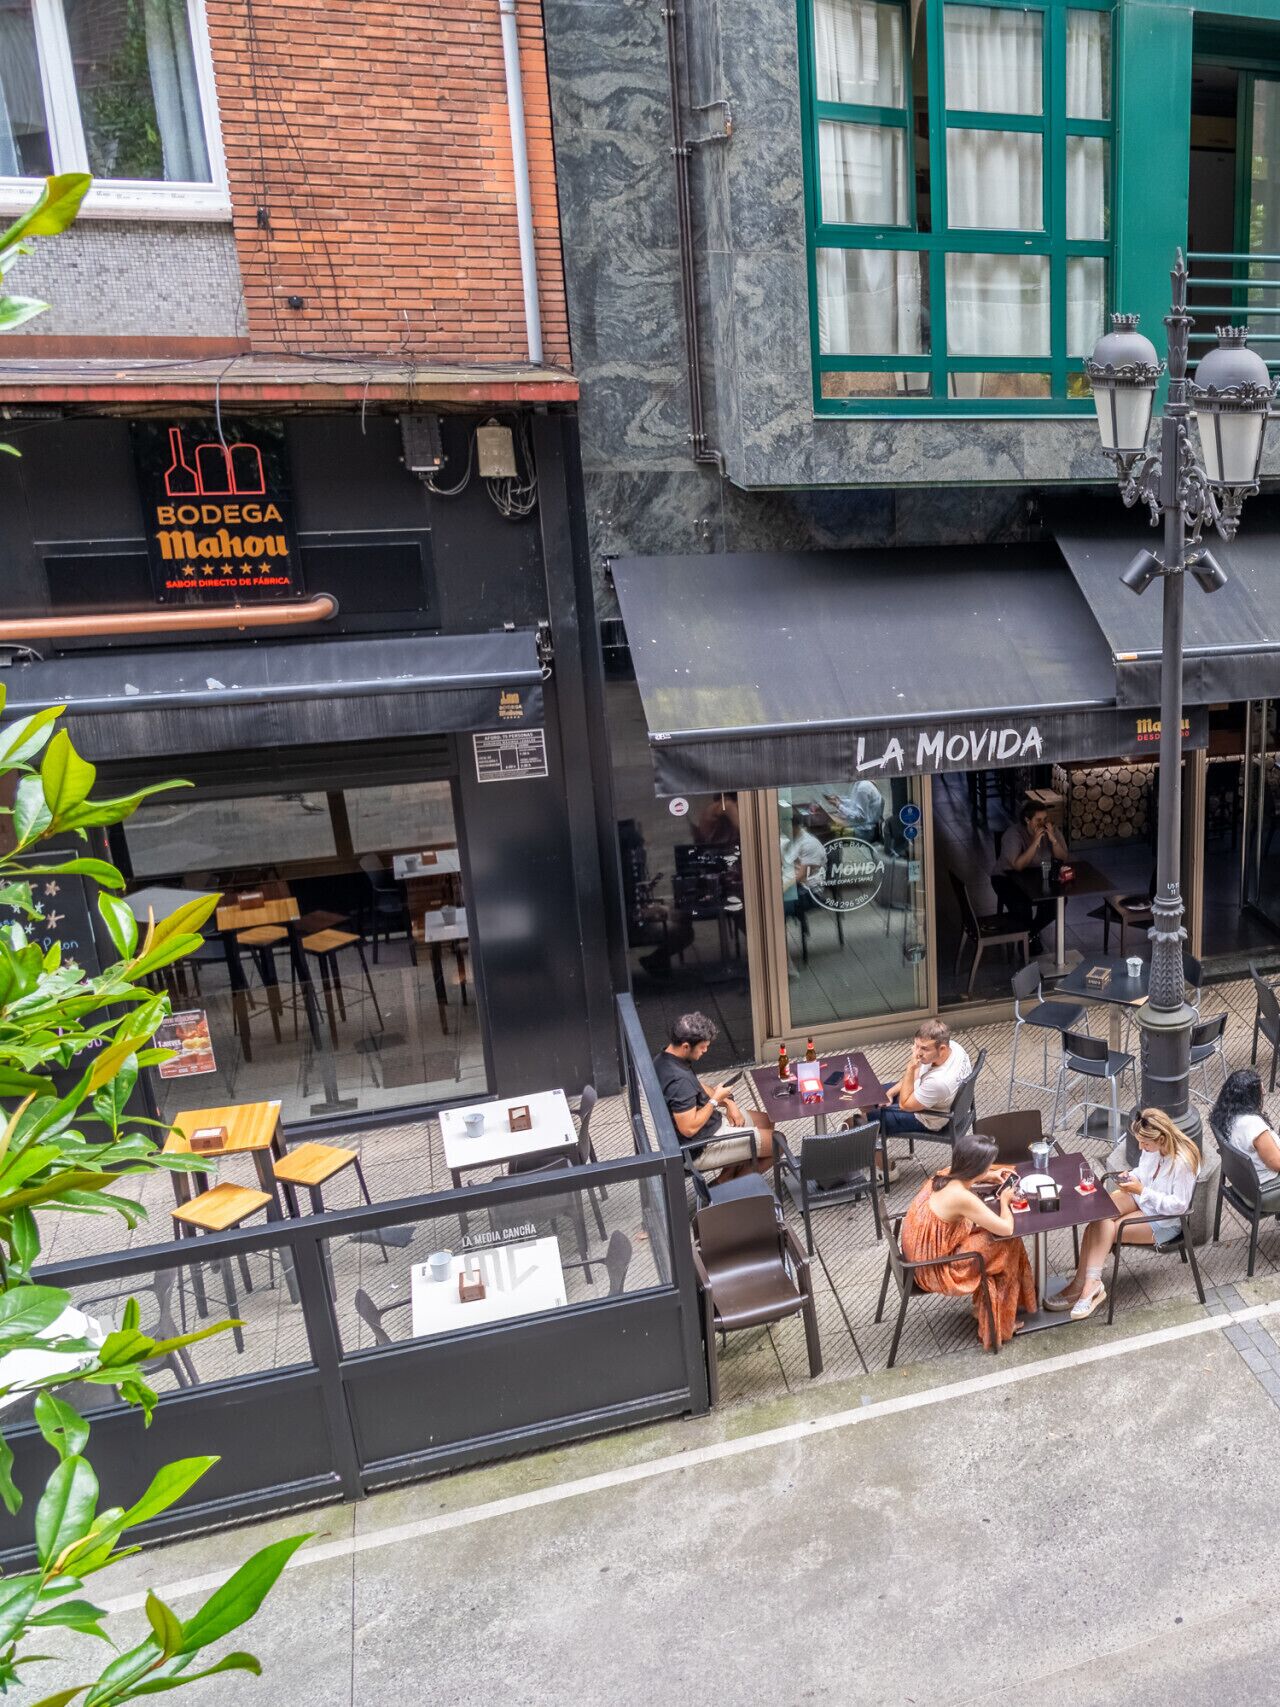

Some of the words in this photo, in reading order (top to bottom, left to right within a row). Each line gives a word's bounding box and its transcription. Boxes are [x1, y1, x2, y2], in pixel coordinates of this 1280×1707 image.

[156, 503, 283, 525] BODEGA
[155, 528, 289, 560] Mahou
[165, 580, 197, 588] SABOR
[199, 578, 237, 587] DIRECTO
[239, 578, 251, 586] DE
[253, 576, 289, 585] FÁBRICA
[1136, 718, 1190, 733] Mau
[1136, 733, 1161, 741] DESD
[856, 737, 905, 772] LA
[916, 726, 1044, 770] MOVIDA
[806, 865, 827, 880] LA
[831, 860, 885, 878] MOVIDA
[462, 1237, 472, 1247] LA
[475, 1231, 500, 1245] MEDIA
[503, 1224, 537, 1239] CANCHA
